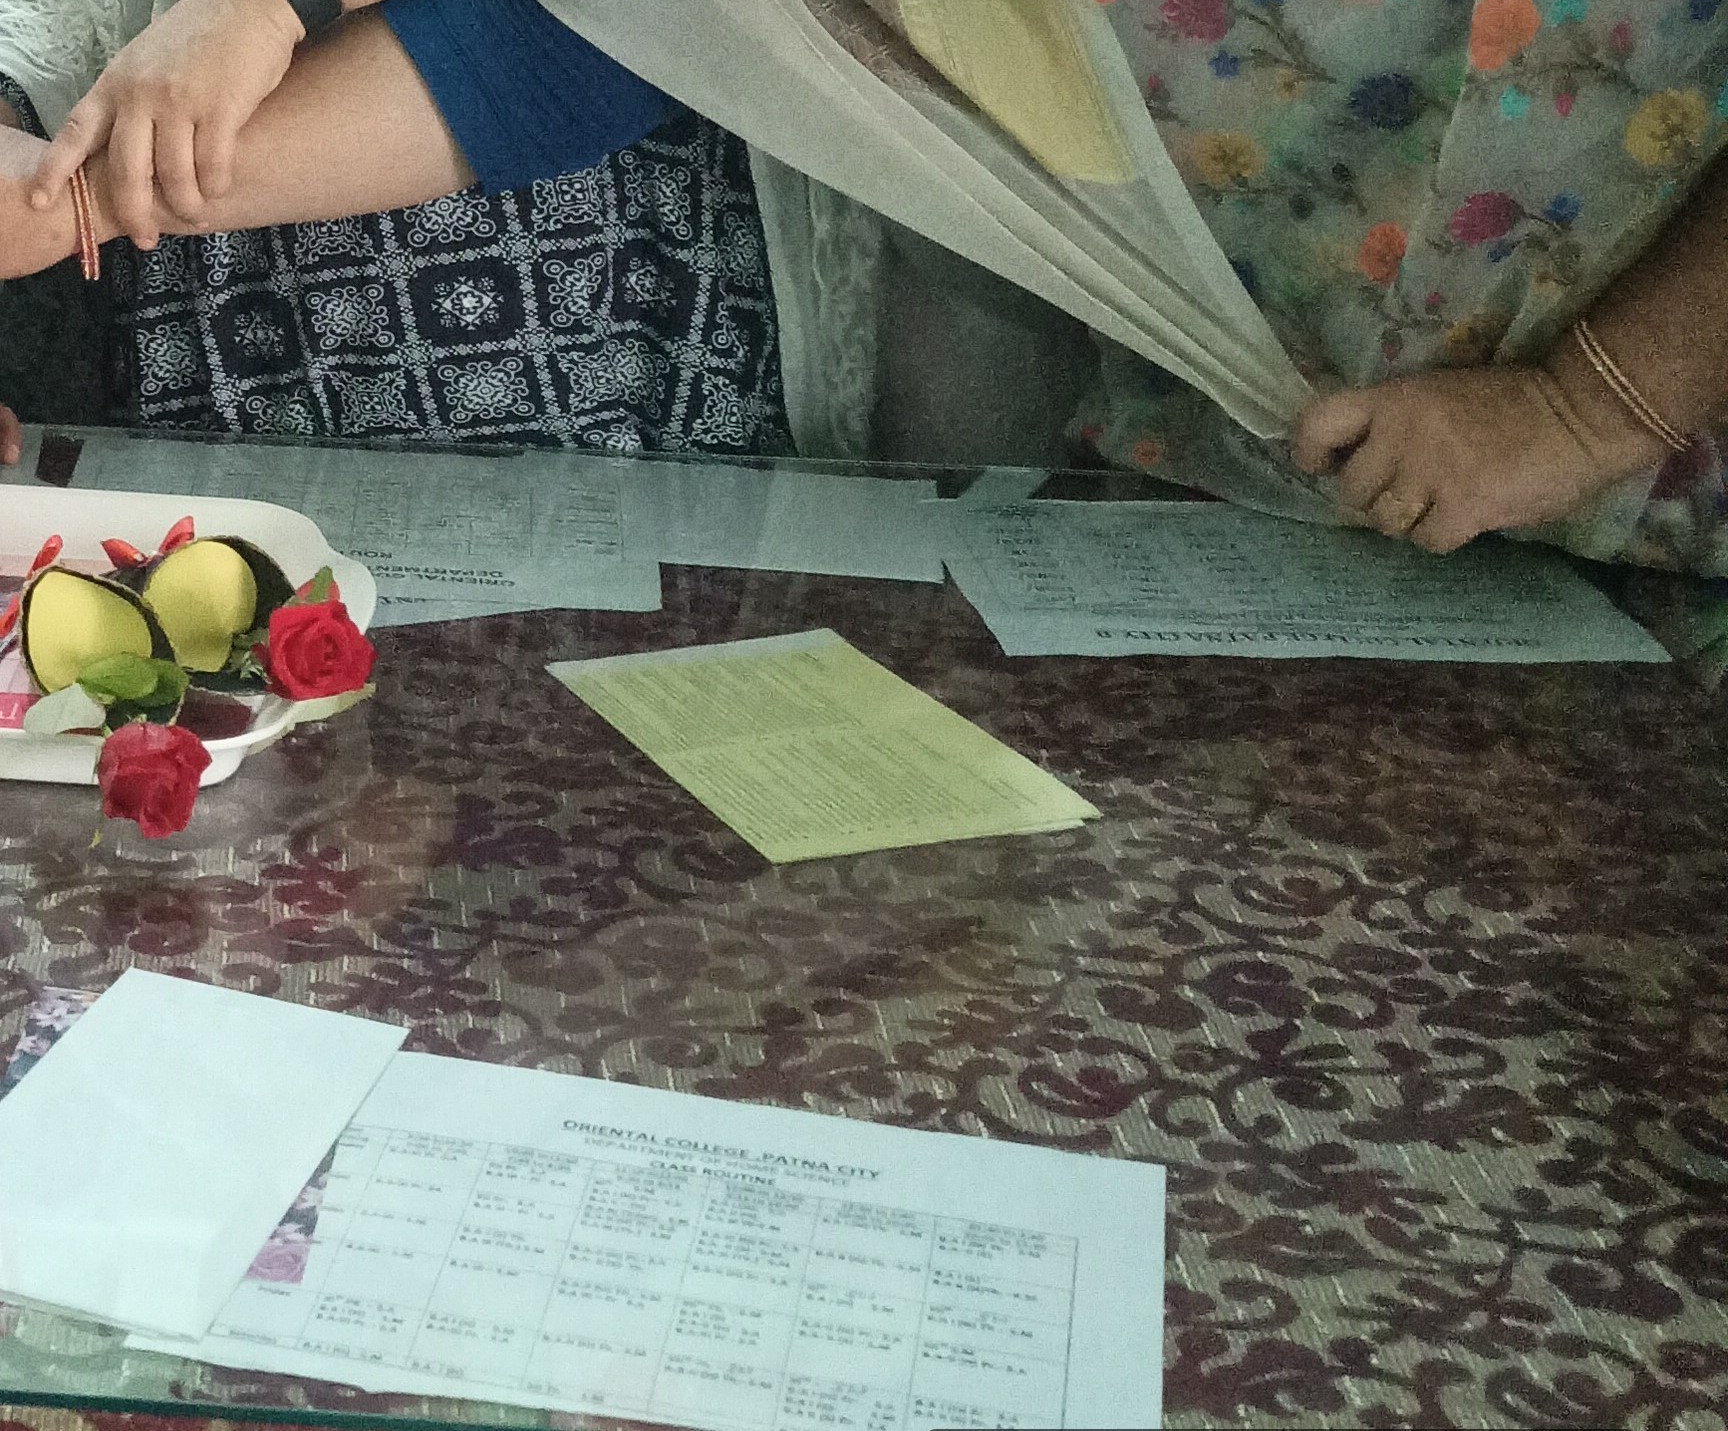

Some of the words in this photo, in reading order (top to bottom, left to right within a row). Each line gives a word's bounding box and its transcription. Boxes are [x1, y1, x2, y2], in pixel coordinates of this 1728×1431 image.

[563, 1119, 658, 1143] ORIENTAL
[665, 1136, 748, 1158] COLLEGE
[837, 1165, 880, 1179] CITY
[584, 1136, 694, 1161] DEPARTMENT
[702, 1168, 775, 1186] ROUTINE
